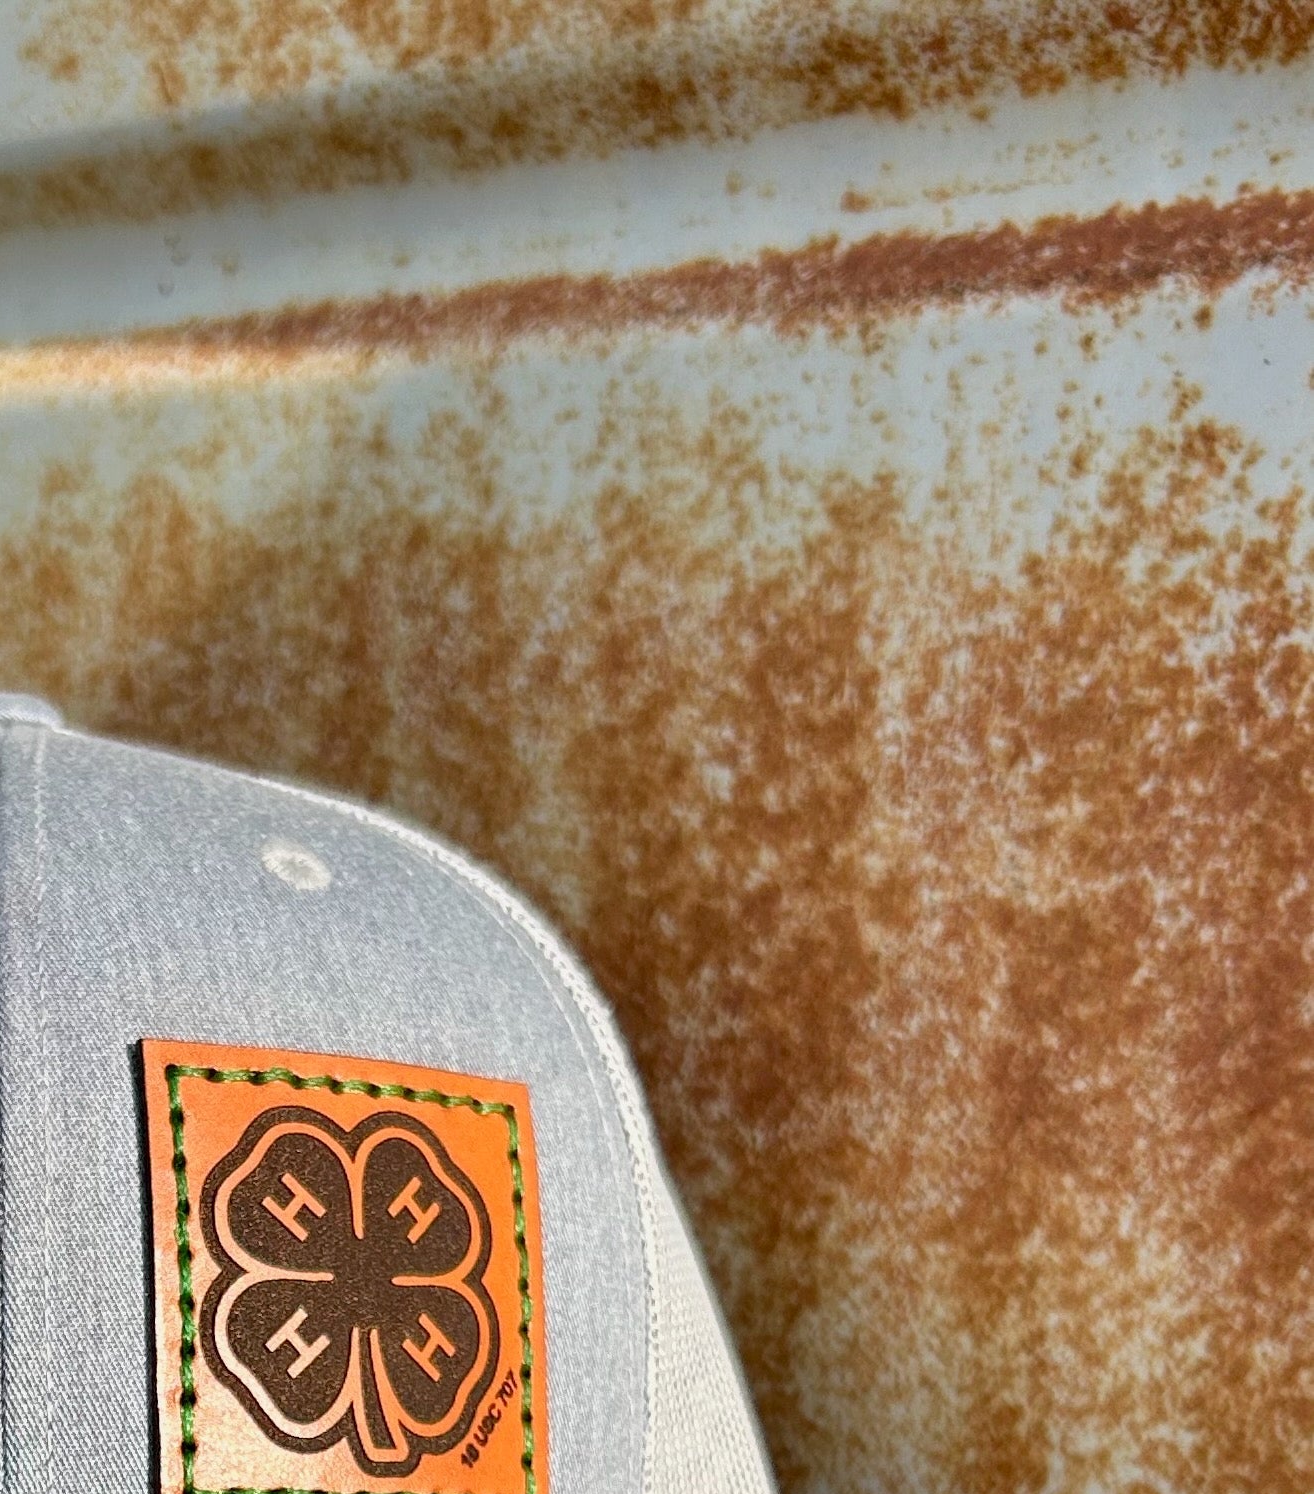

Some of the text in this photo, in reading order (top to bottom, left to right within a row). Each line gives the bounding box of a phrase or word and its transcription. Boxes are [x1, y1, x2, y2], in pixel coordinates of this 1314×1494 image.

[262, 1172, 326, 1243] H
[388, 1176, 441, 1244] H
[265, 1307, 332, 1379] H
[402, 1313, 457, 1383] H
[494, 1367, 518, 1408] 707
